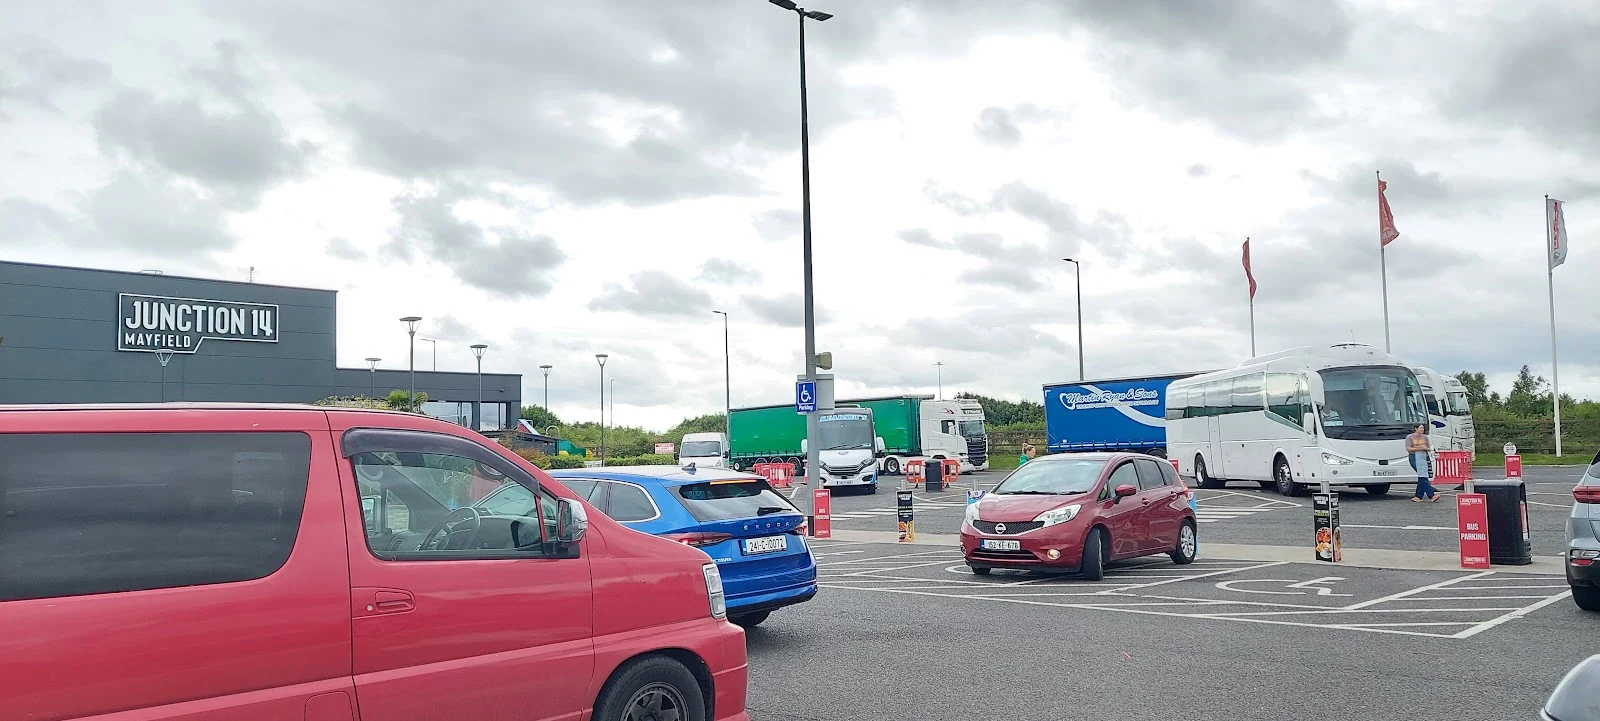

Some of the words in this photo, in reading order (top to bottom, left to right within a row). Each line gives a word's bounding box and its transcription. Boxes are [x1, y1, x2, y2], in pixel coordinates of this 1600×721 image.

[126, 301, 245, 335] JUNCTION
[252, 309, 272, 337] 14
[125, 332, 191, 348] MAYFIELD
[1066, 392, 1102, 404] Martin
[1102, 389, 1124, 402] Ryan
[1126, 388, 1135, 400] &
[1134, 387, 1158, 400] Sons
[1466, 523, 1479, 531] BUS
[1460, 533, 1486, 541] PARKING
[750, 538, 784, 552] 241-C-10072
